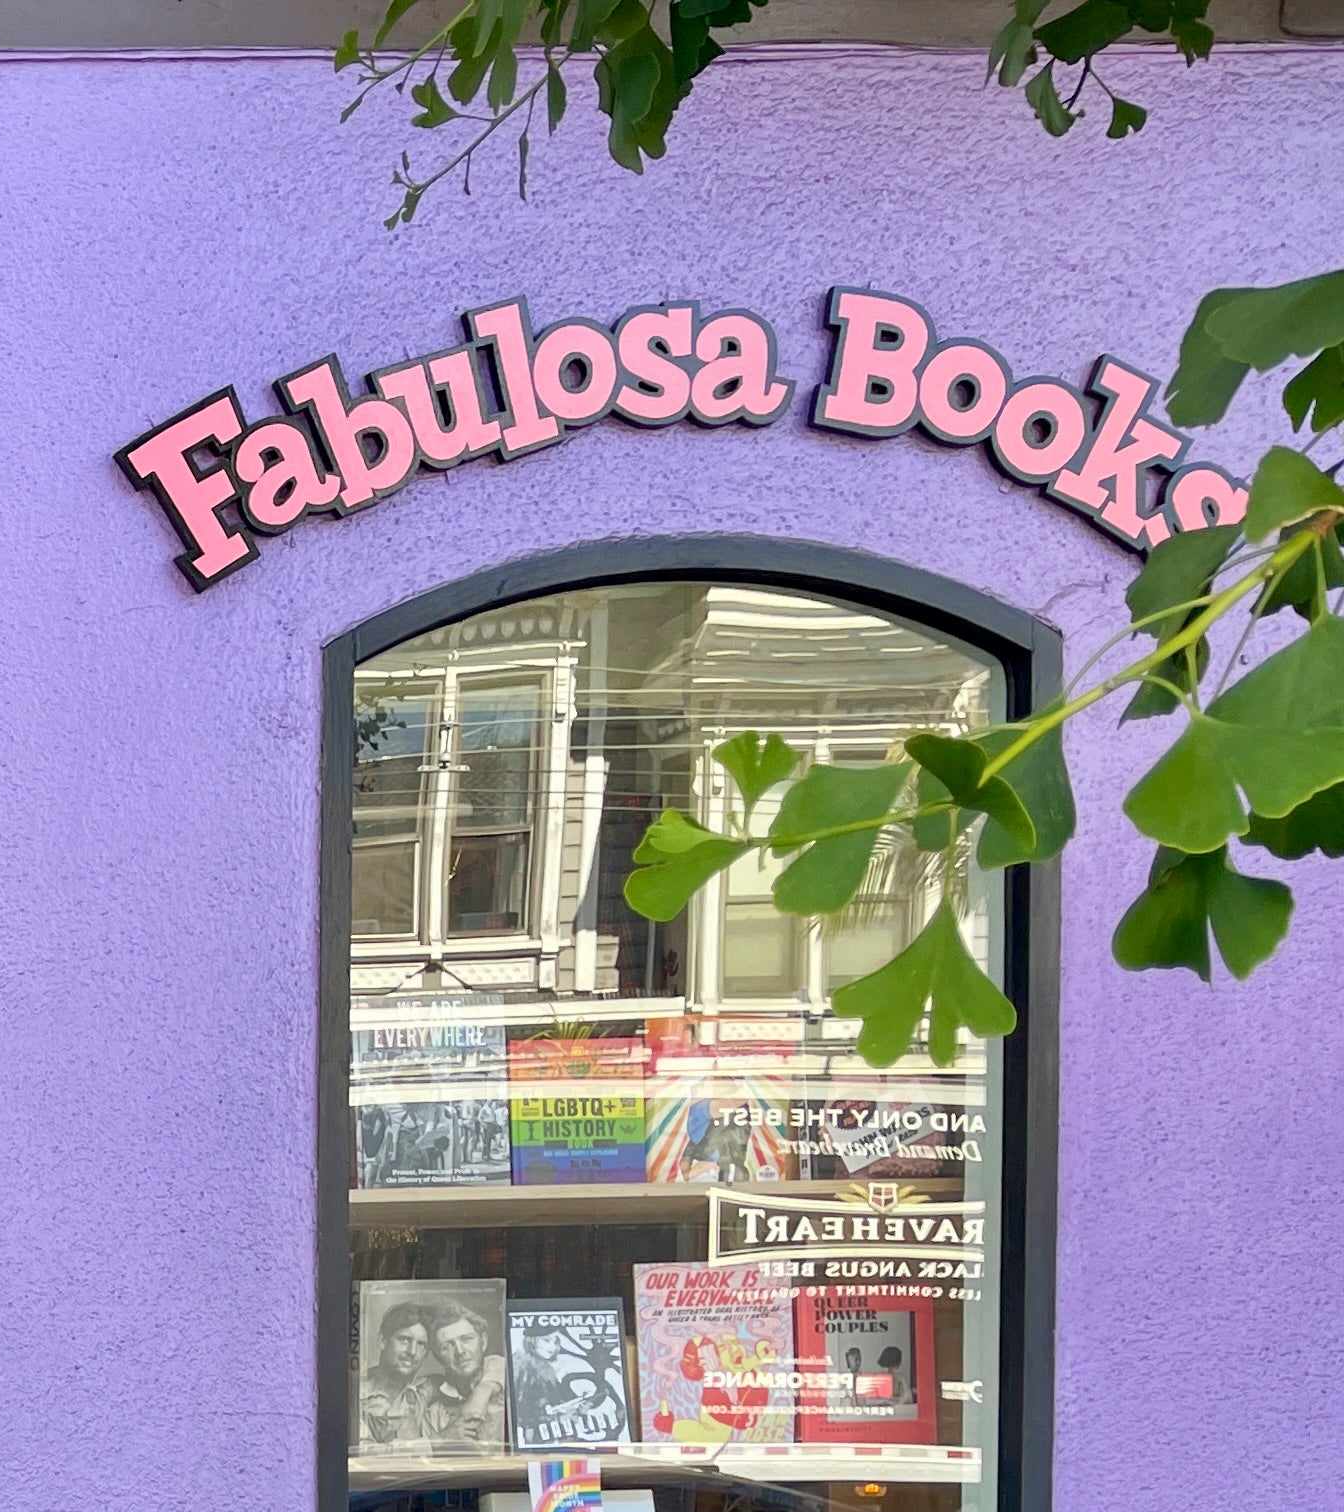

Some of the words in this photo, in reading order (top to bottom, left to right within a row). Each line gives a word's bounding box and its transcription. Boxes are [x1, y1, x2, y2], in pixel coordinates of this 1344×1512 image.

[116, 297, 794, 595] Fabulosa
[374, 1026, 487, 1048] EVERYWHERE
[543, 1098, 617, 1117] LGBTQ+
[543, 1120, 616, 1137] HISTORY
[646, 1273, 679, 1289] OUR
[684, 1271, 734, 1289] WORK
[741, 1270, 760, 1287] IS
[814, 1297, 868, 1309] QUEER
[512, 1316, 533, 1327] MY
[538, 1315, 615, 1327] COMRADE
[815, 1309, 876, 1321] POWER
[815, 1321, 889, 1334] COUPLES
